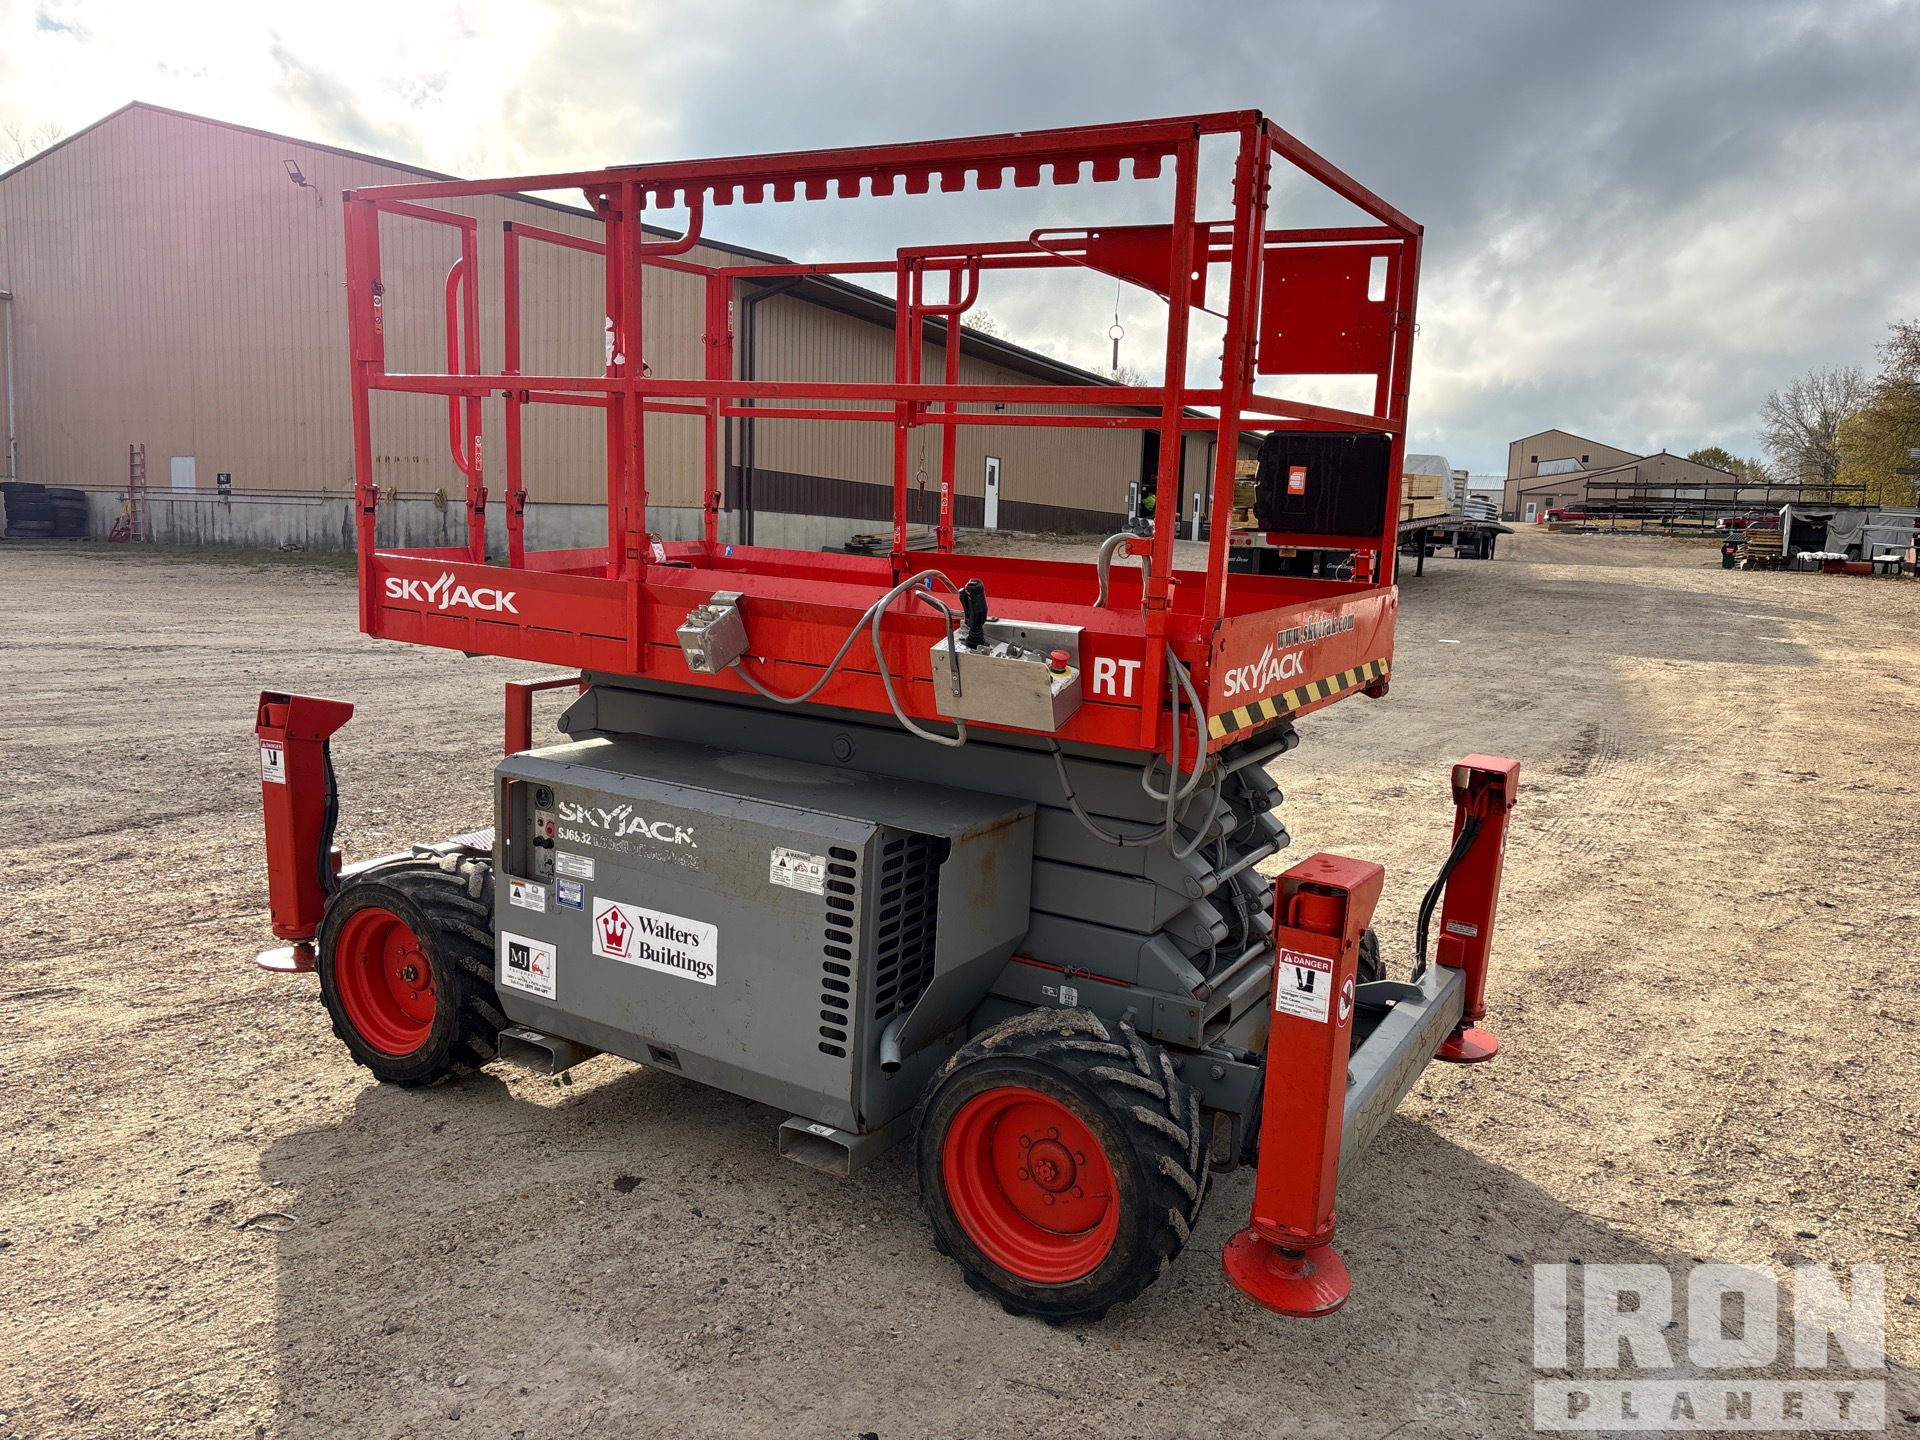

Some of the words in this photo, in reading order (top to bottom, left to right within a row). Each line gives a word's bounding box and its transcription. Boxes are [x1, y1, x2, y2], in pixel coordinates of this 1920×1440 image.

[385, 571, 519, 614] SKYJACK
[1277, 611, 1355, 650] www.skytrak.com
[1093, 656, 1141, 698] RT
[1223, 642, 1304, 698] SKYJACK
[558, 801, 698, 848] SKYJACK
[638, 915, 699, 947] Walters
[510, 947, 528, 968] MJ
[638, 940, 714, 979] Buildings
[1293, 956, 1329, 971] DANGER
